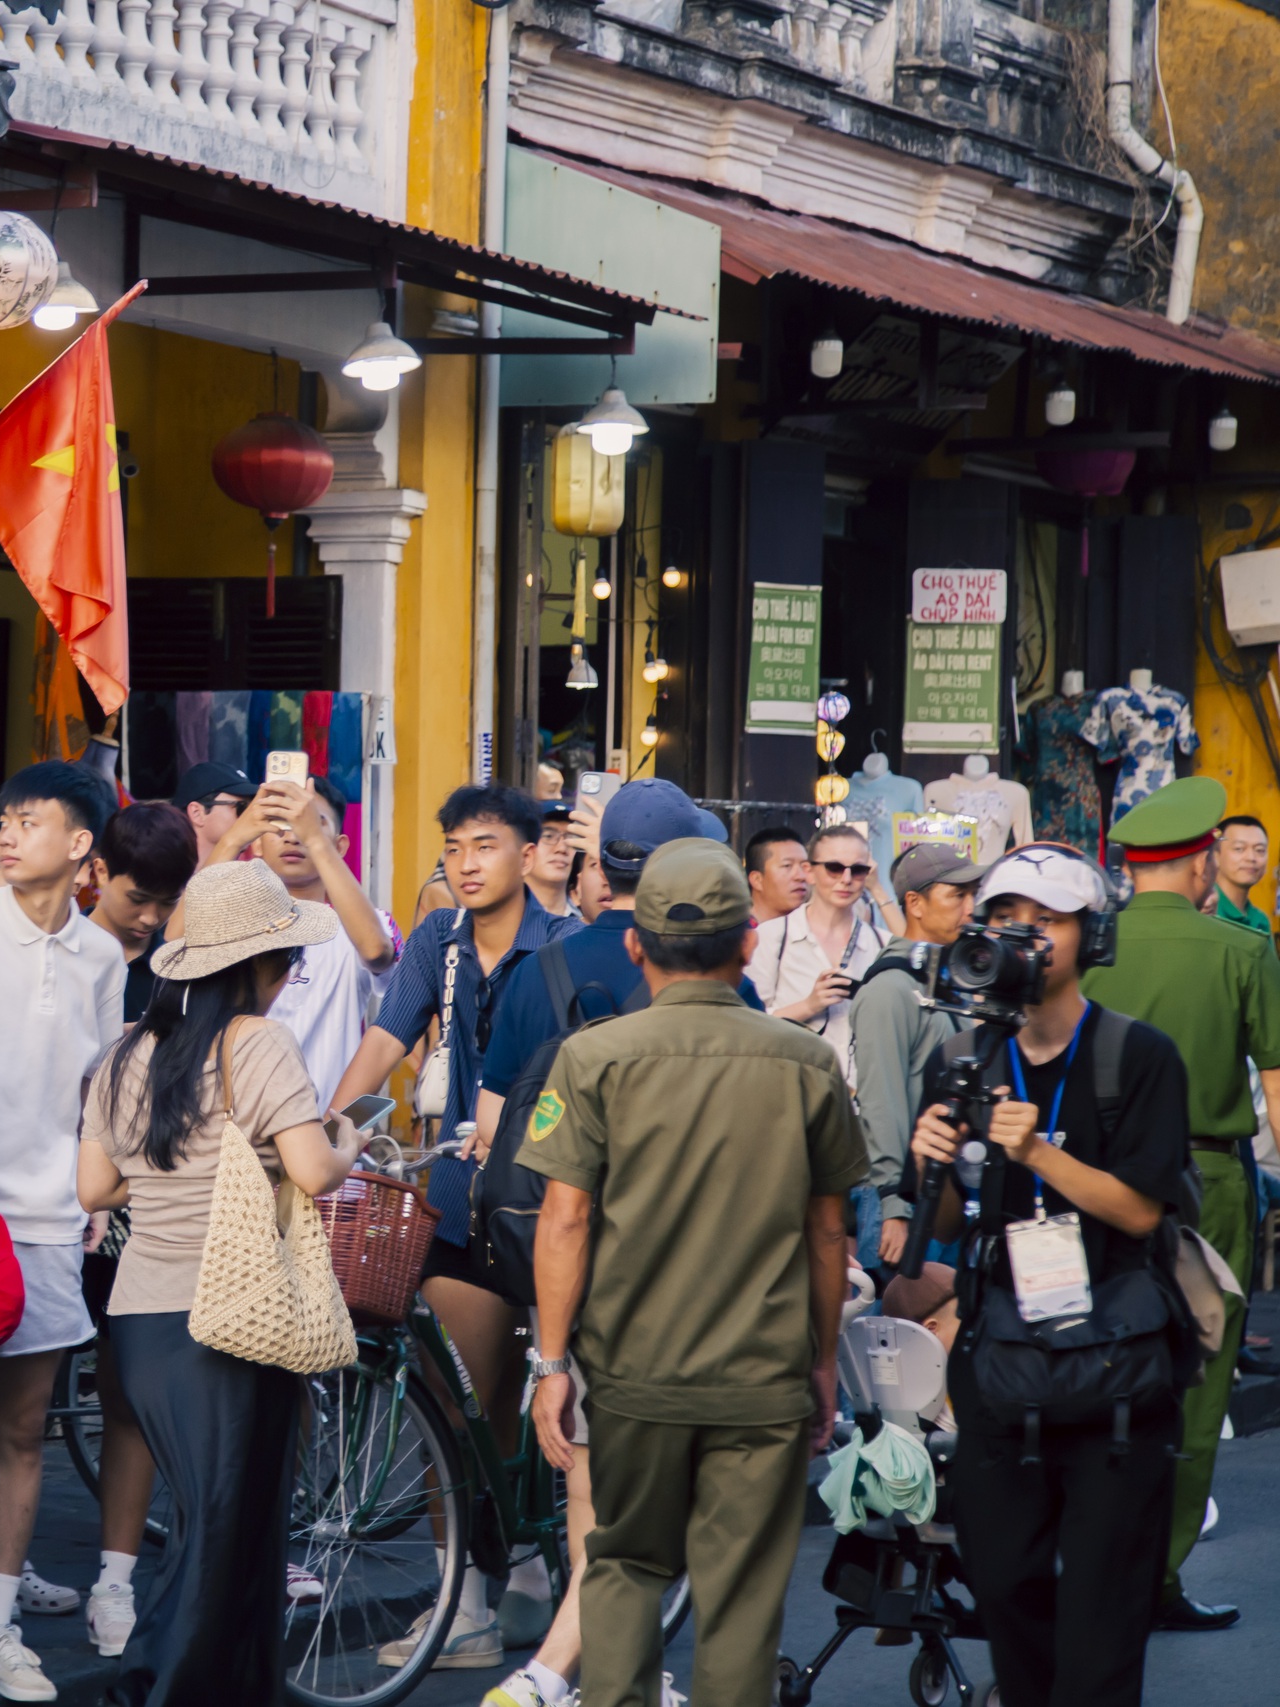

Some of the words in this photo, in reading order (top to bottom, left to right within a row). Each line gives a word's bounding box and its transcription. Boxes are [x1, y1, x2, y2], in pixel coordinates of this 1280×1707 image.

[921, 574, 954, 590] CHO
[794, 627, 814, 645] RENT
[946, 654, 966, 671] FOR
[967, 654, 993, 671] RENT
